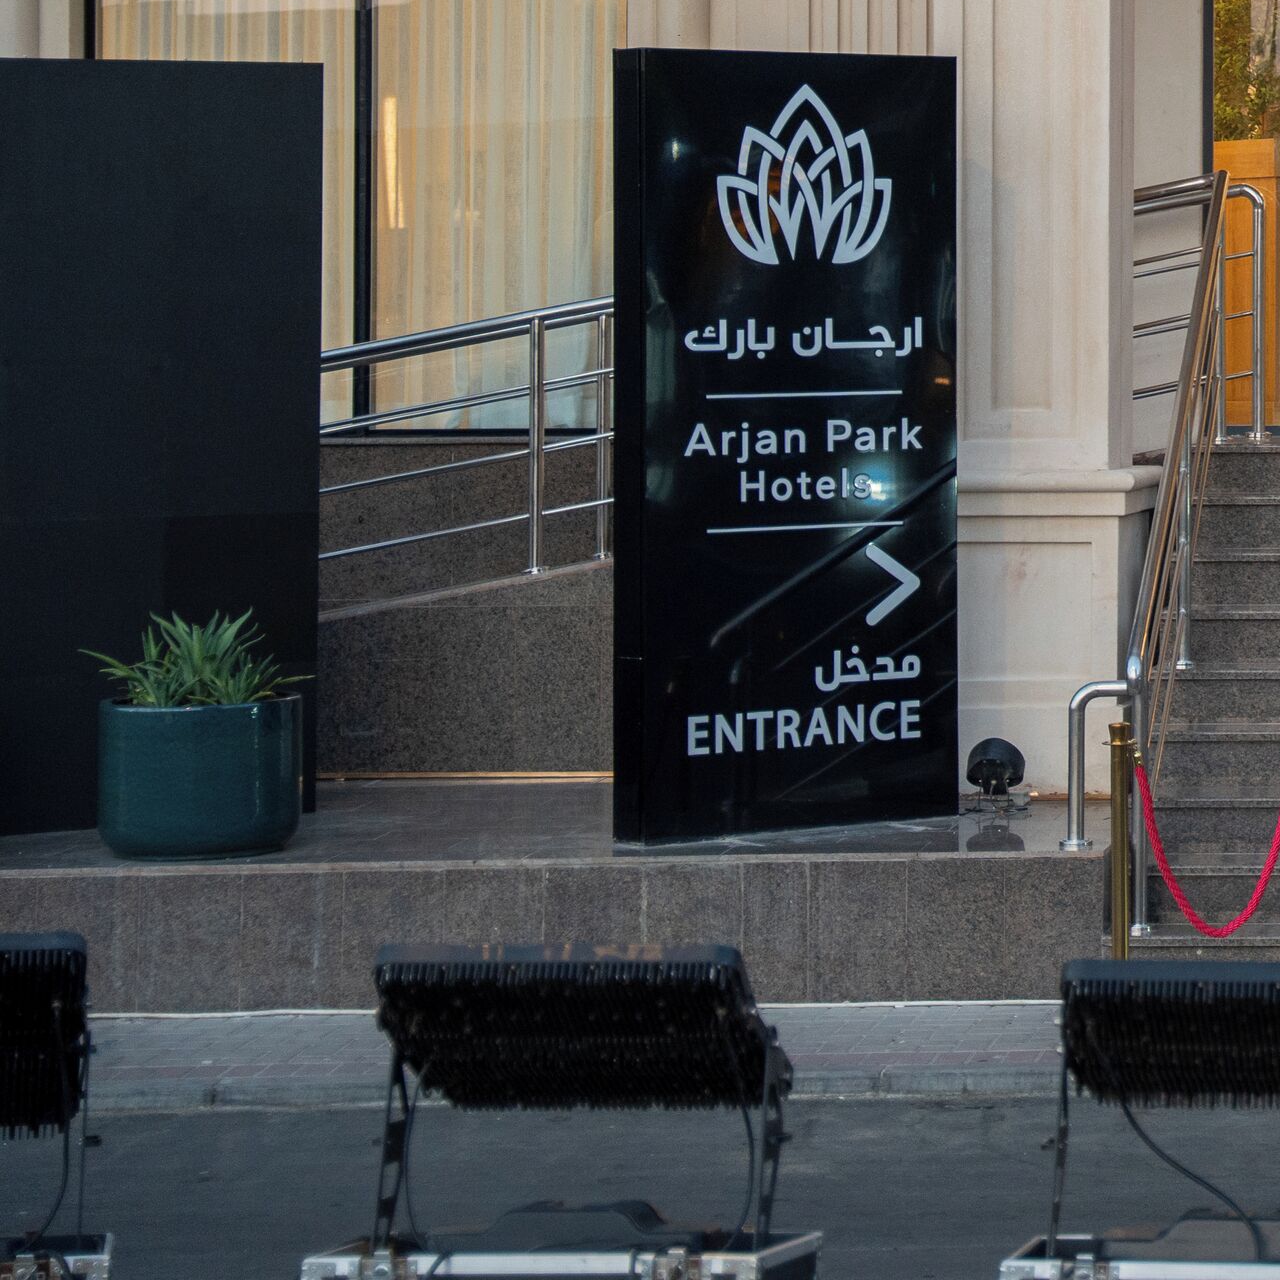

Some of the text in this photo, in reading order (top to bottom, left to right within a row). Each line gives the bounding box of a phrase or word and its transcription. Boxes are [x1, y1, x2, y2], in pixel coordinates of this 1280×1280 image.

[684, 316, 923, 360] ارجان بارك
[684, 417, 924, 464] Arjan Park
[740, 467, 872, 503] Hotels
[814, 645, 922, 691] مدخل
[686, 699, 922, 757] ENTRANCE
